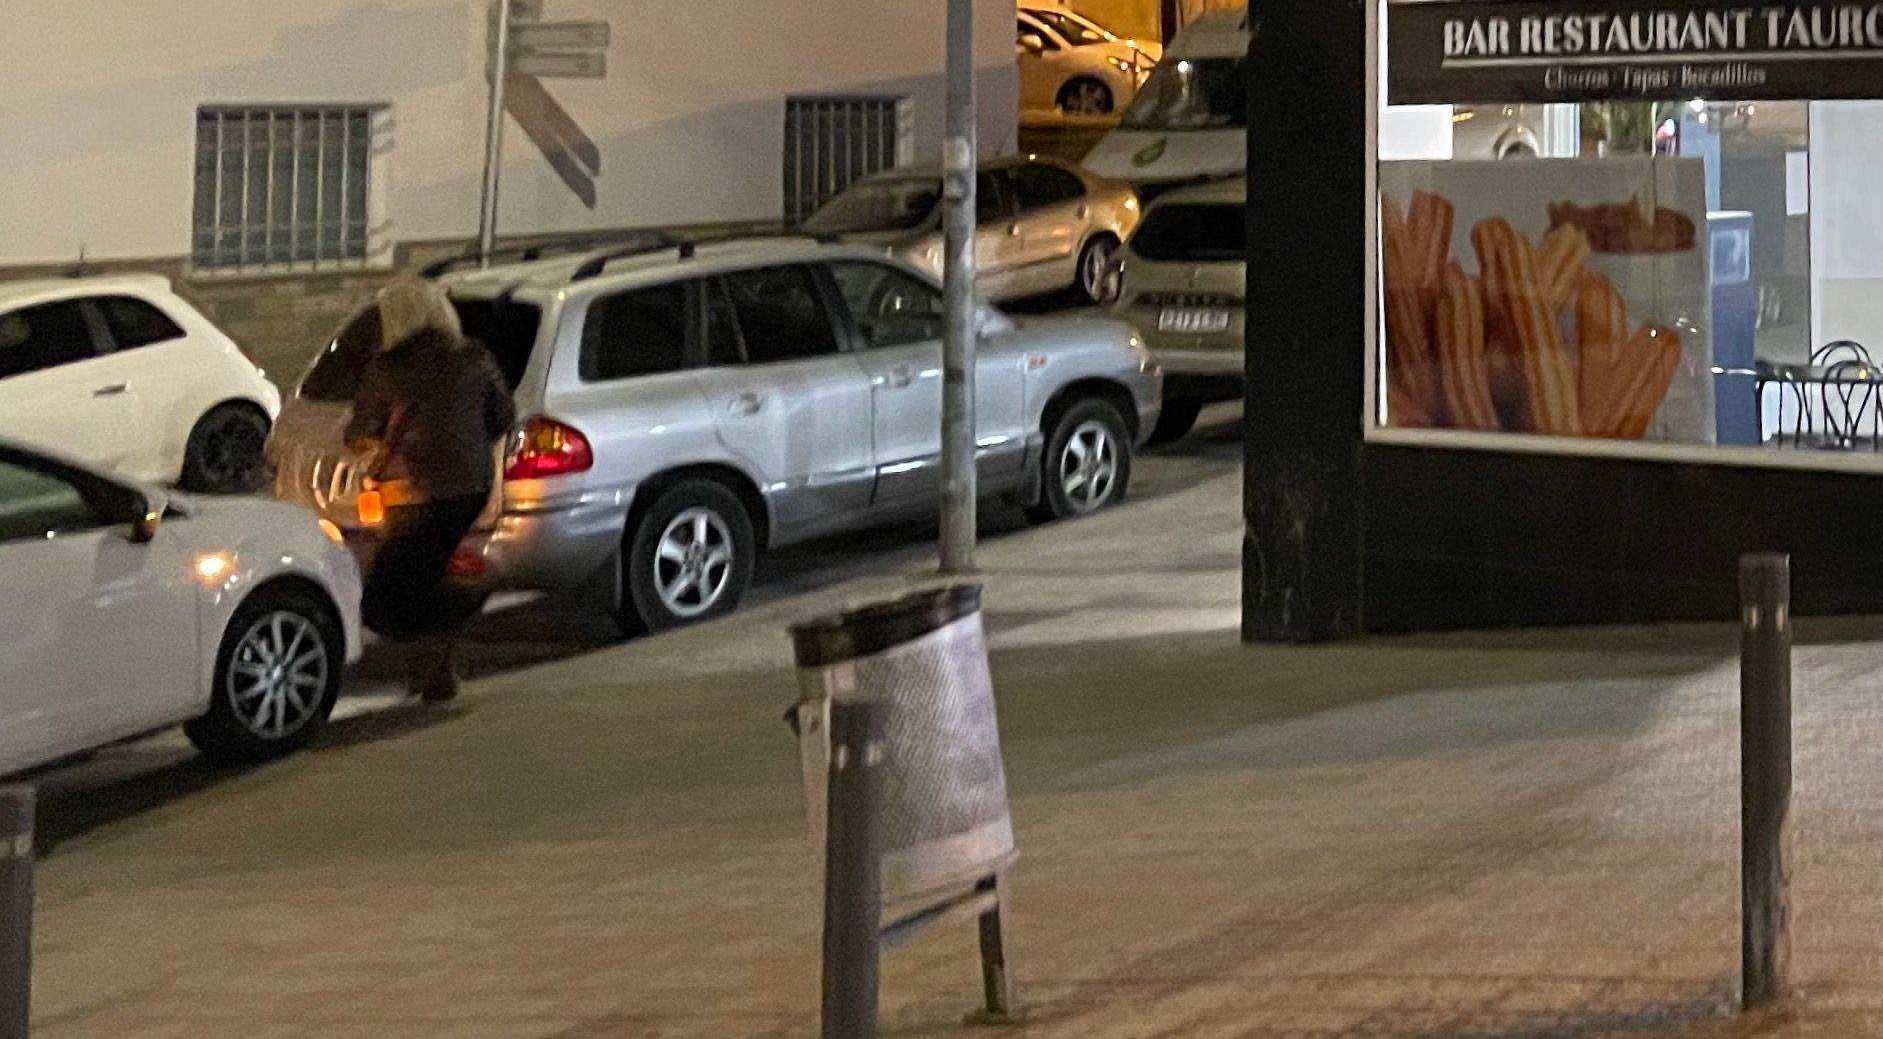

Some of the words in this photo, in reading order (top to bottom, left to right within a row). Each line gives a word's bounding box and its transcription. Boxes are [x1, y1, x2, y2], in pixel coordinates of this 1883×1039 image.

[1444, 17, 1510, 56] BAR
[1520, 8, 1752, 53] RESTAURANT
[1544, 65, 1610, 90] Churros
[1624, 65, 1669, 94] Tapas
[1681, 63, 1766, 89] Bocadillos
